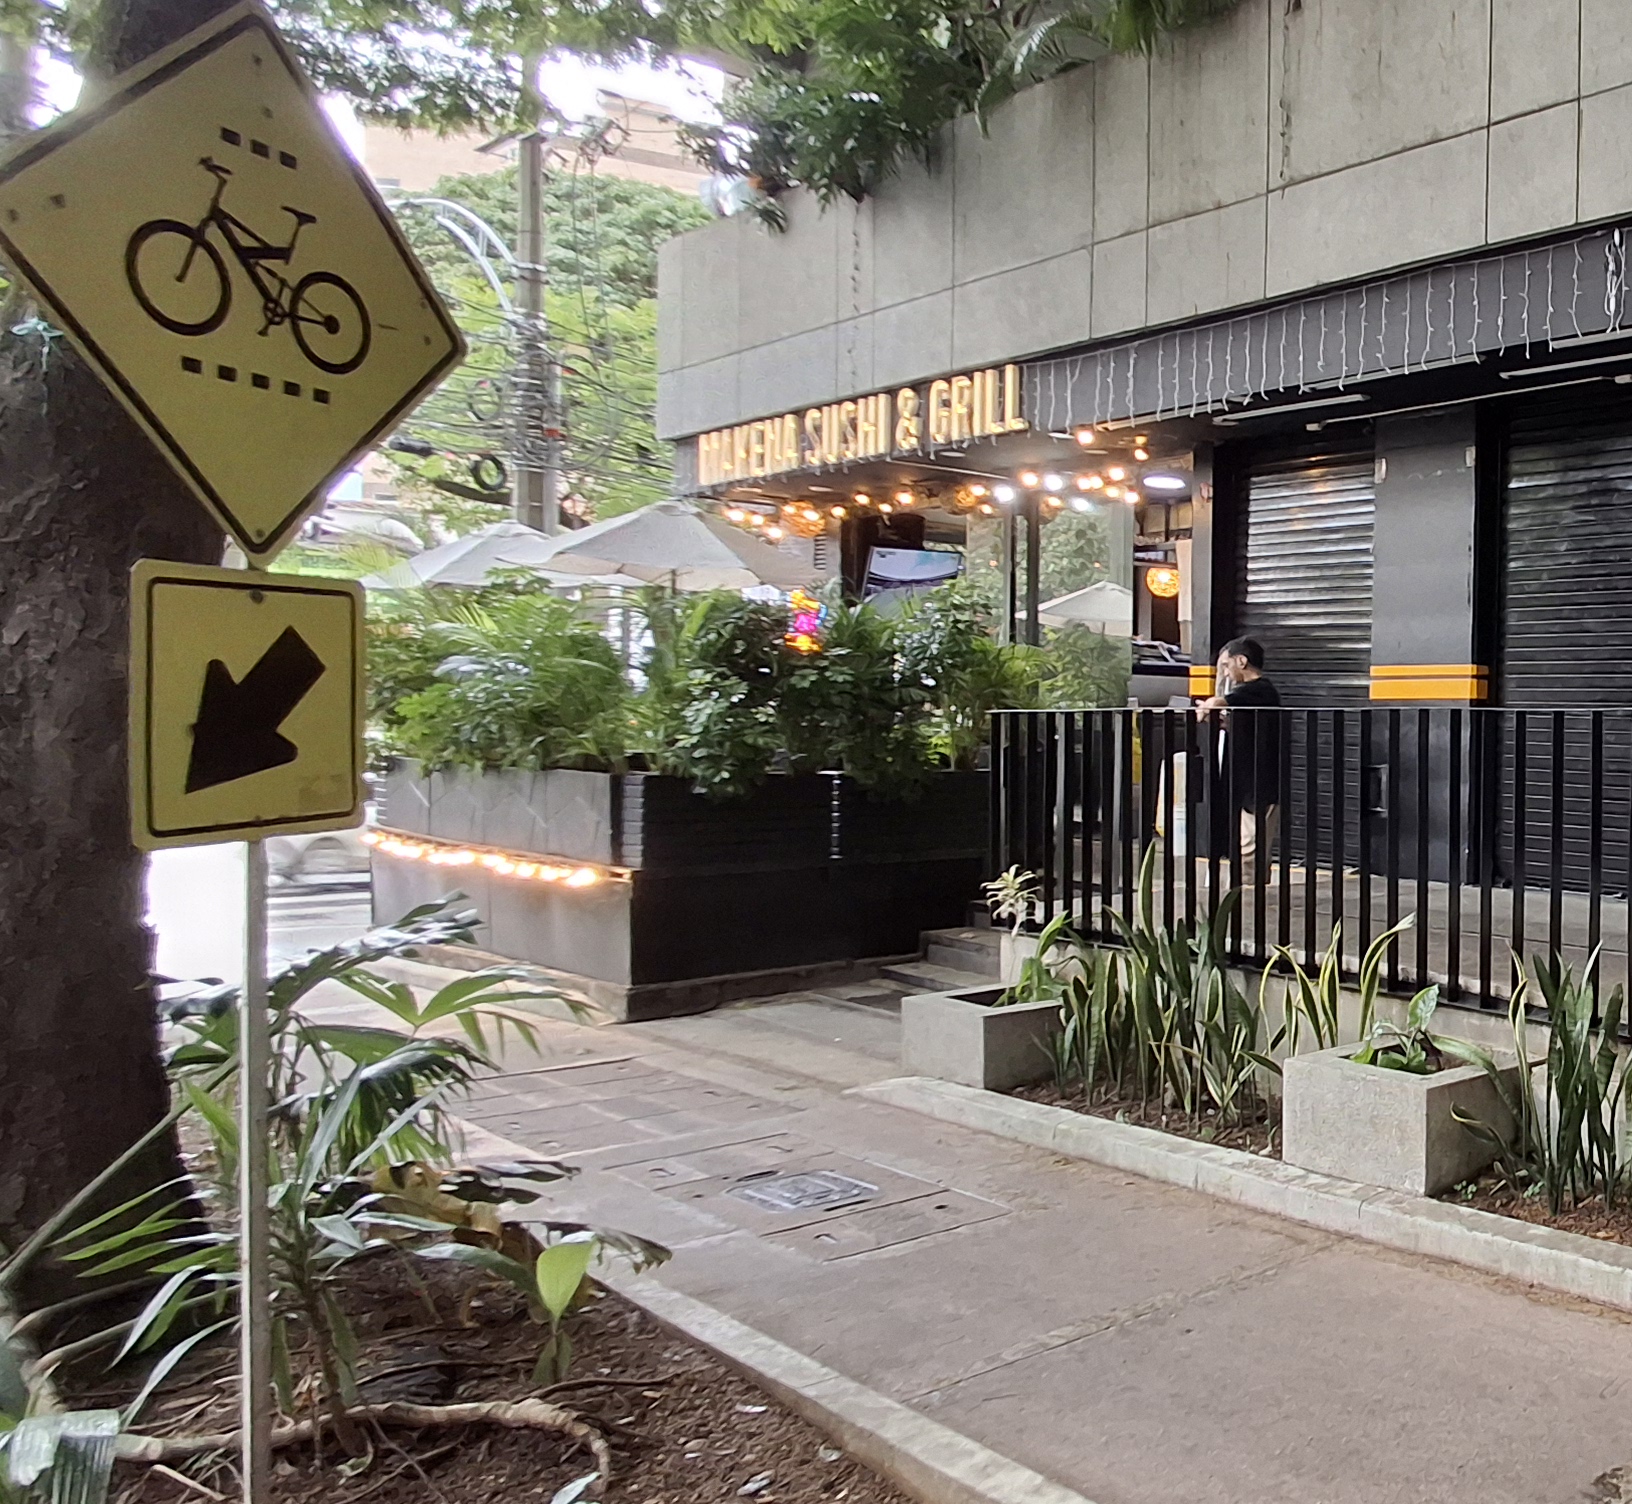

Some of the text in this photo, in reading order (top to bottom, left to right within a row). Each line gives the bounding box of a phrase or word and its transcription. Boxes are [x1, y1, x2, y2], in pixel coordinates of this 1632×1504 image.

[698, 363, 1030, 486] MAKENA SUSHI & GRILL
